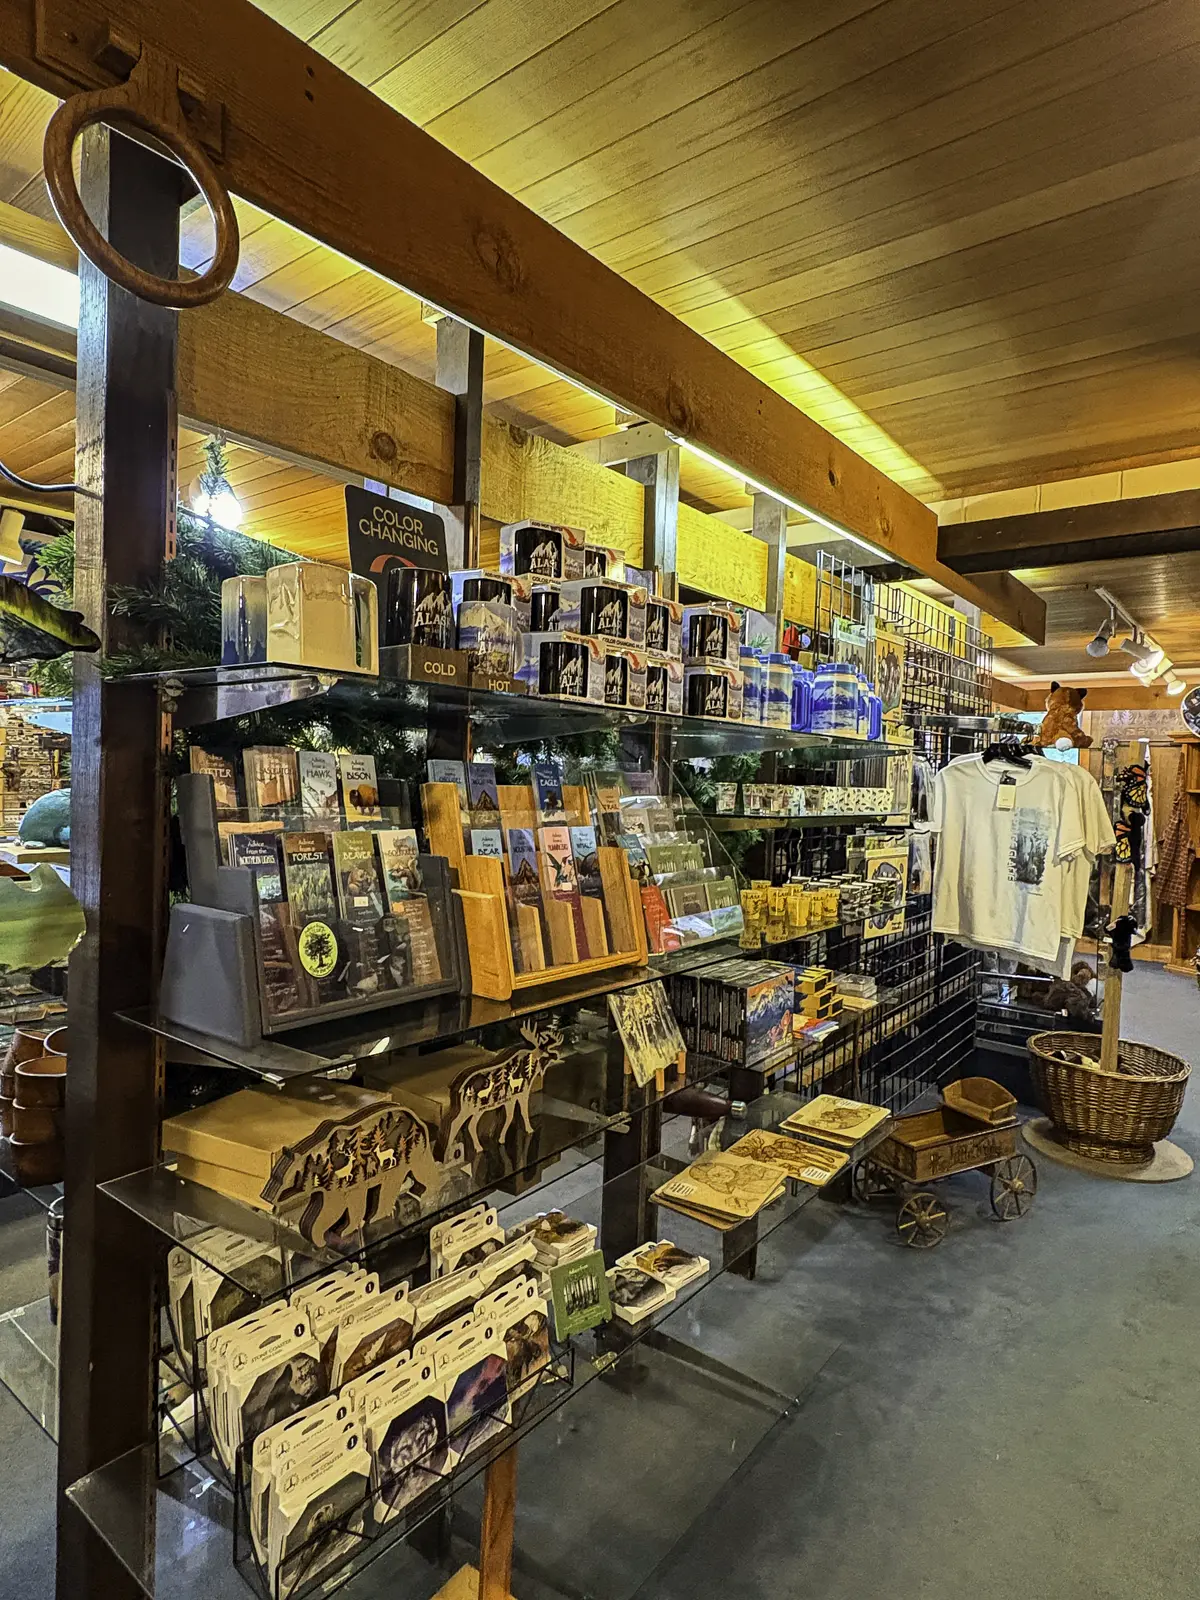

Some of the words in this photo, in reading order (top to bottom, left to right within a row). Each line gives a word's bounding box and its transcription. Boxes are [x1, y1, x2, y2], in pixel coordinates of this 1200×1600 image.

[373, 506, 424, 535] COLOR
[359, 518, 439, 556] CHANGING
[415, 611, 449, 627] ALAS
[424, 662, 456, 676] COLD
[488, 679, 511, 692] HOT
[306, 770, 332, 779] HAWK
[346, 771, 371, 780] BISON
[540, 779, 558, 787] EAGLE
[247, 840, 265, 848] Advice
[343, 851, 372, 861] BEAVER
[478, 847, 500, 855] BEAR
[292, 852, 324, 862] FOREST
[251, 1350, 268, 1363] STONE
[268, 1338, 292, 1353] COASTER
